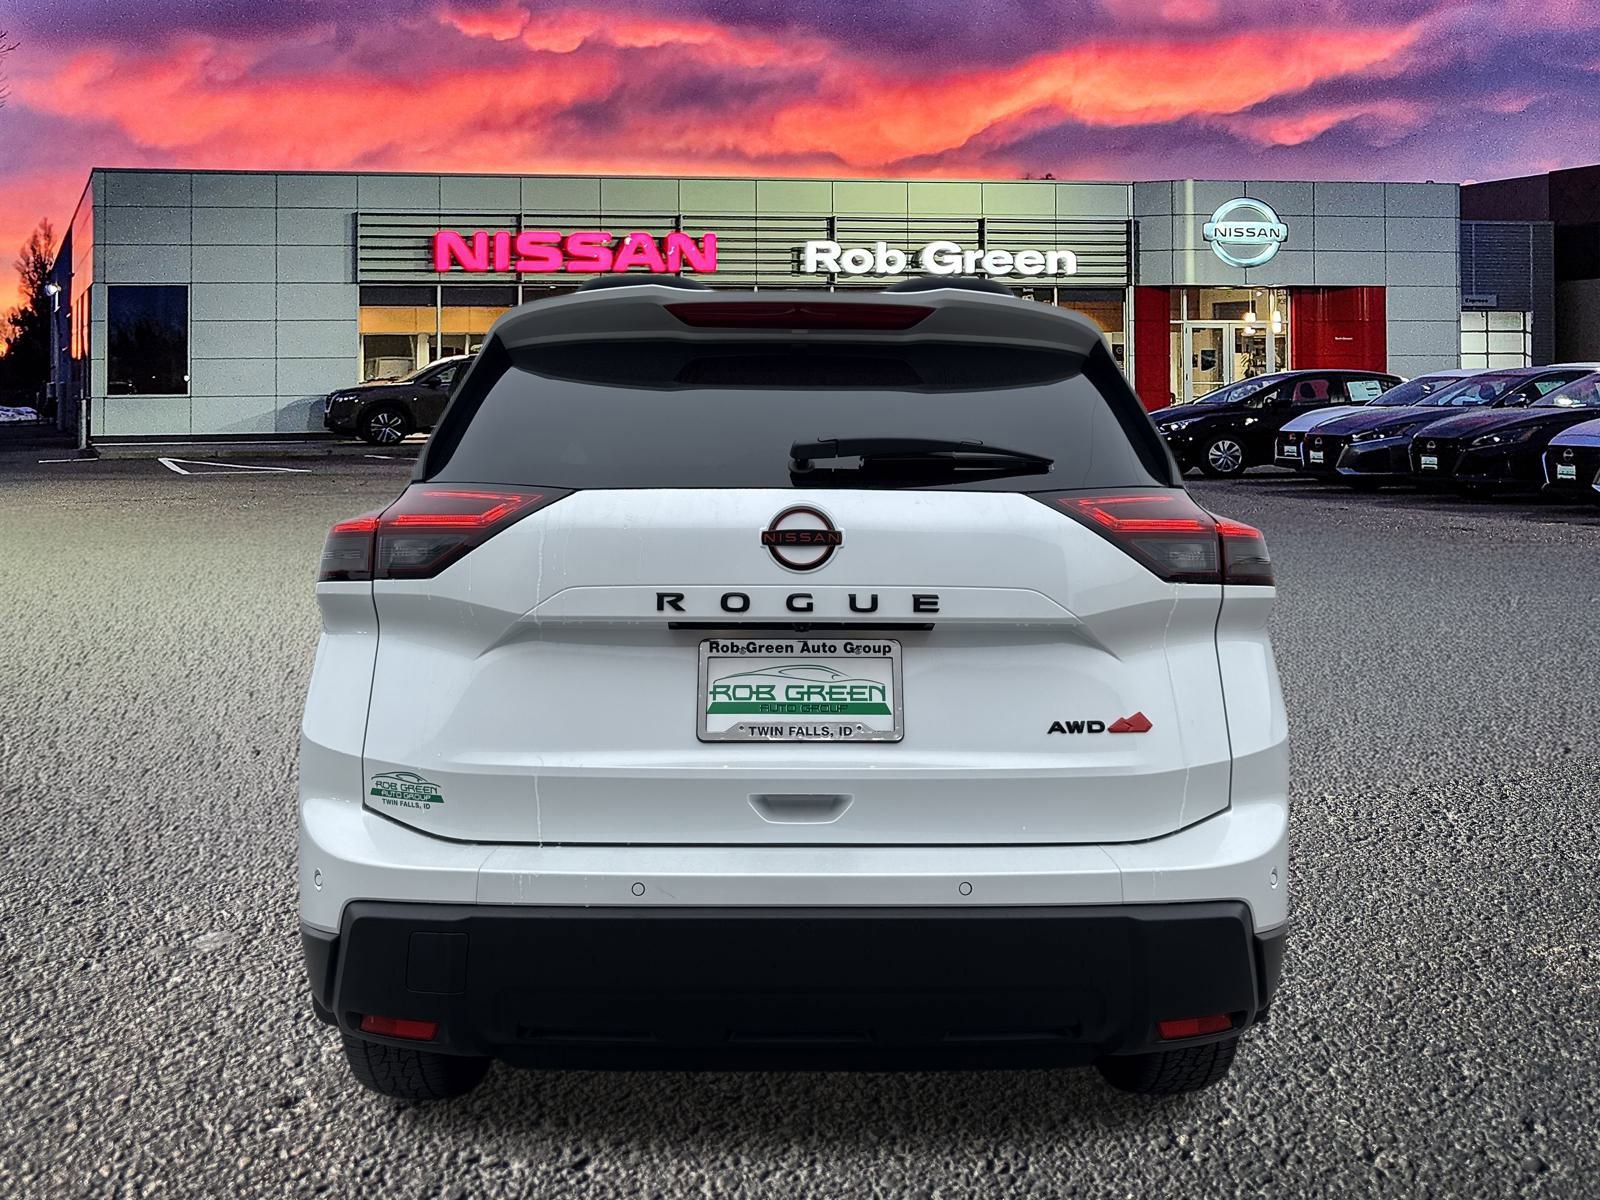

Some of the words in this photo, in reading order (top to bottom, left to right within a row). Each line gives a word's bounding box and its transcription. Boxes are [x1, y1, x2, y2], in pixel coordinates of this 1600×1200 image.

[1214, 227, 1280, 238] NISSAN
[434, 231, 717, 273] NISSAN
[803, 240, 907, 275] Rob
[921, 240, 1078, 275] Green
[763, 532, 840, 543] NISSAN
[656, 592, 940, 613] ROGUE
[708, 641, 741, 654] Rob
[746, 642, 794, 654] Green
[799, 642, 838, 654] Auto
[843, 642, 892, 656] Group
[709, 685, 776, 701] ROB
[785, 685, 886, 702] GREEN
[760, 704, 796, 713] AUTO
[800, 704, 849, 713] GROUP
[748, 726, 783, 736] TWIN
[788, 726, 834, 738] FALLS,
[839, 726, 853, 736] ID
[1047, 720, 1106, 734] AWD
[375, 781, 397, 790] ROB
[400, 783, 438, 794] GREEN
[381, 790, 402, 799] AUTO
[403, 792, 431, 801] GROUP
